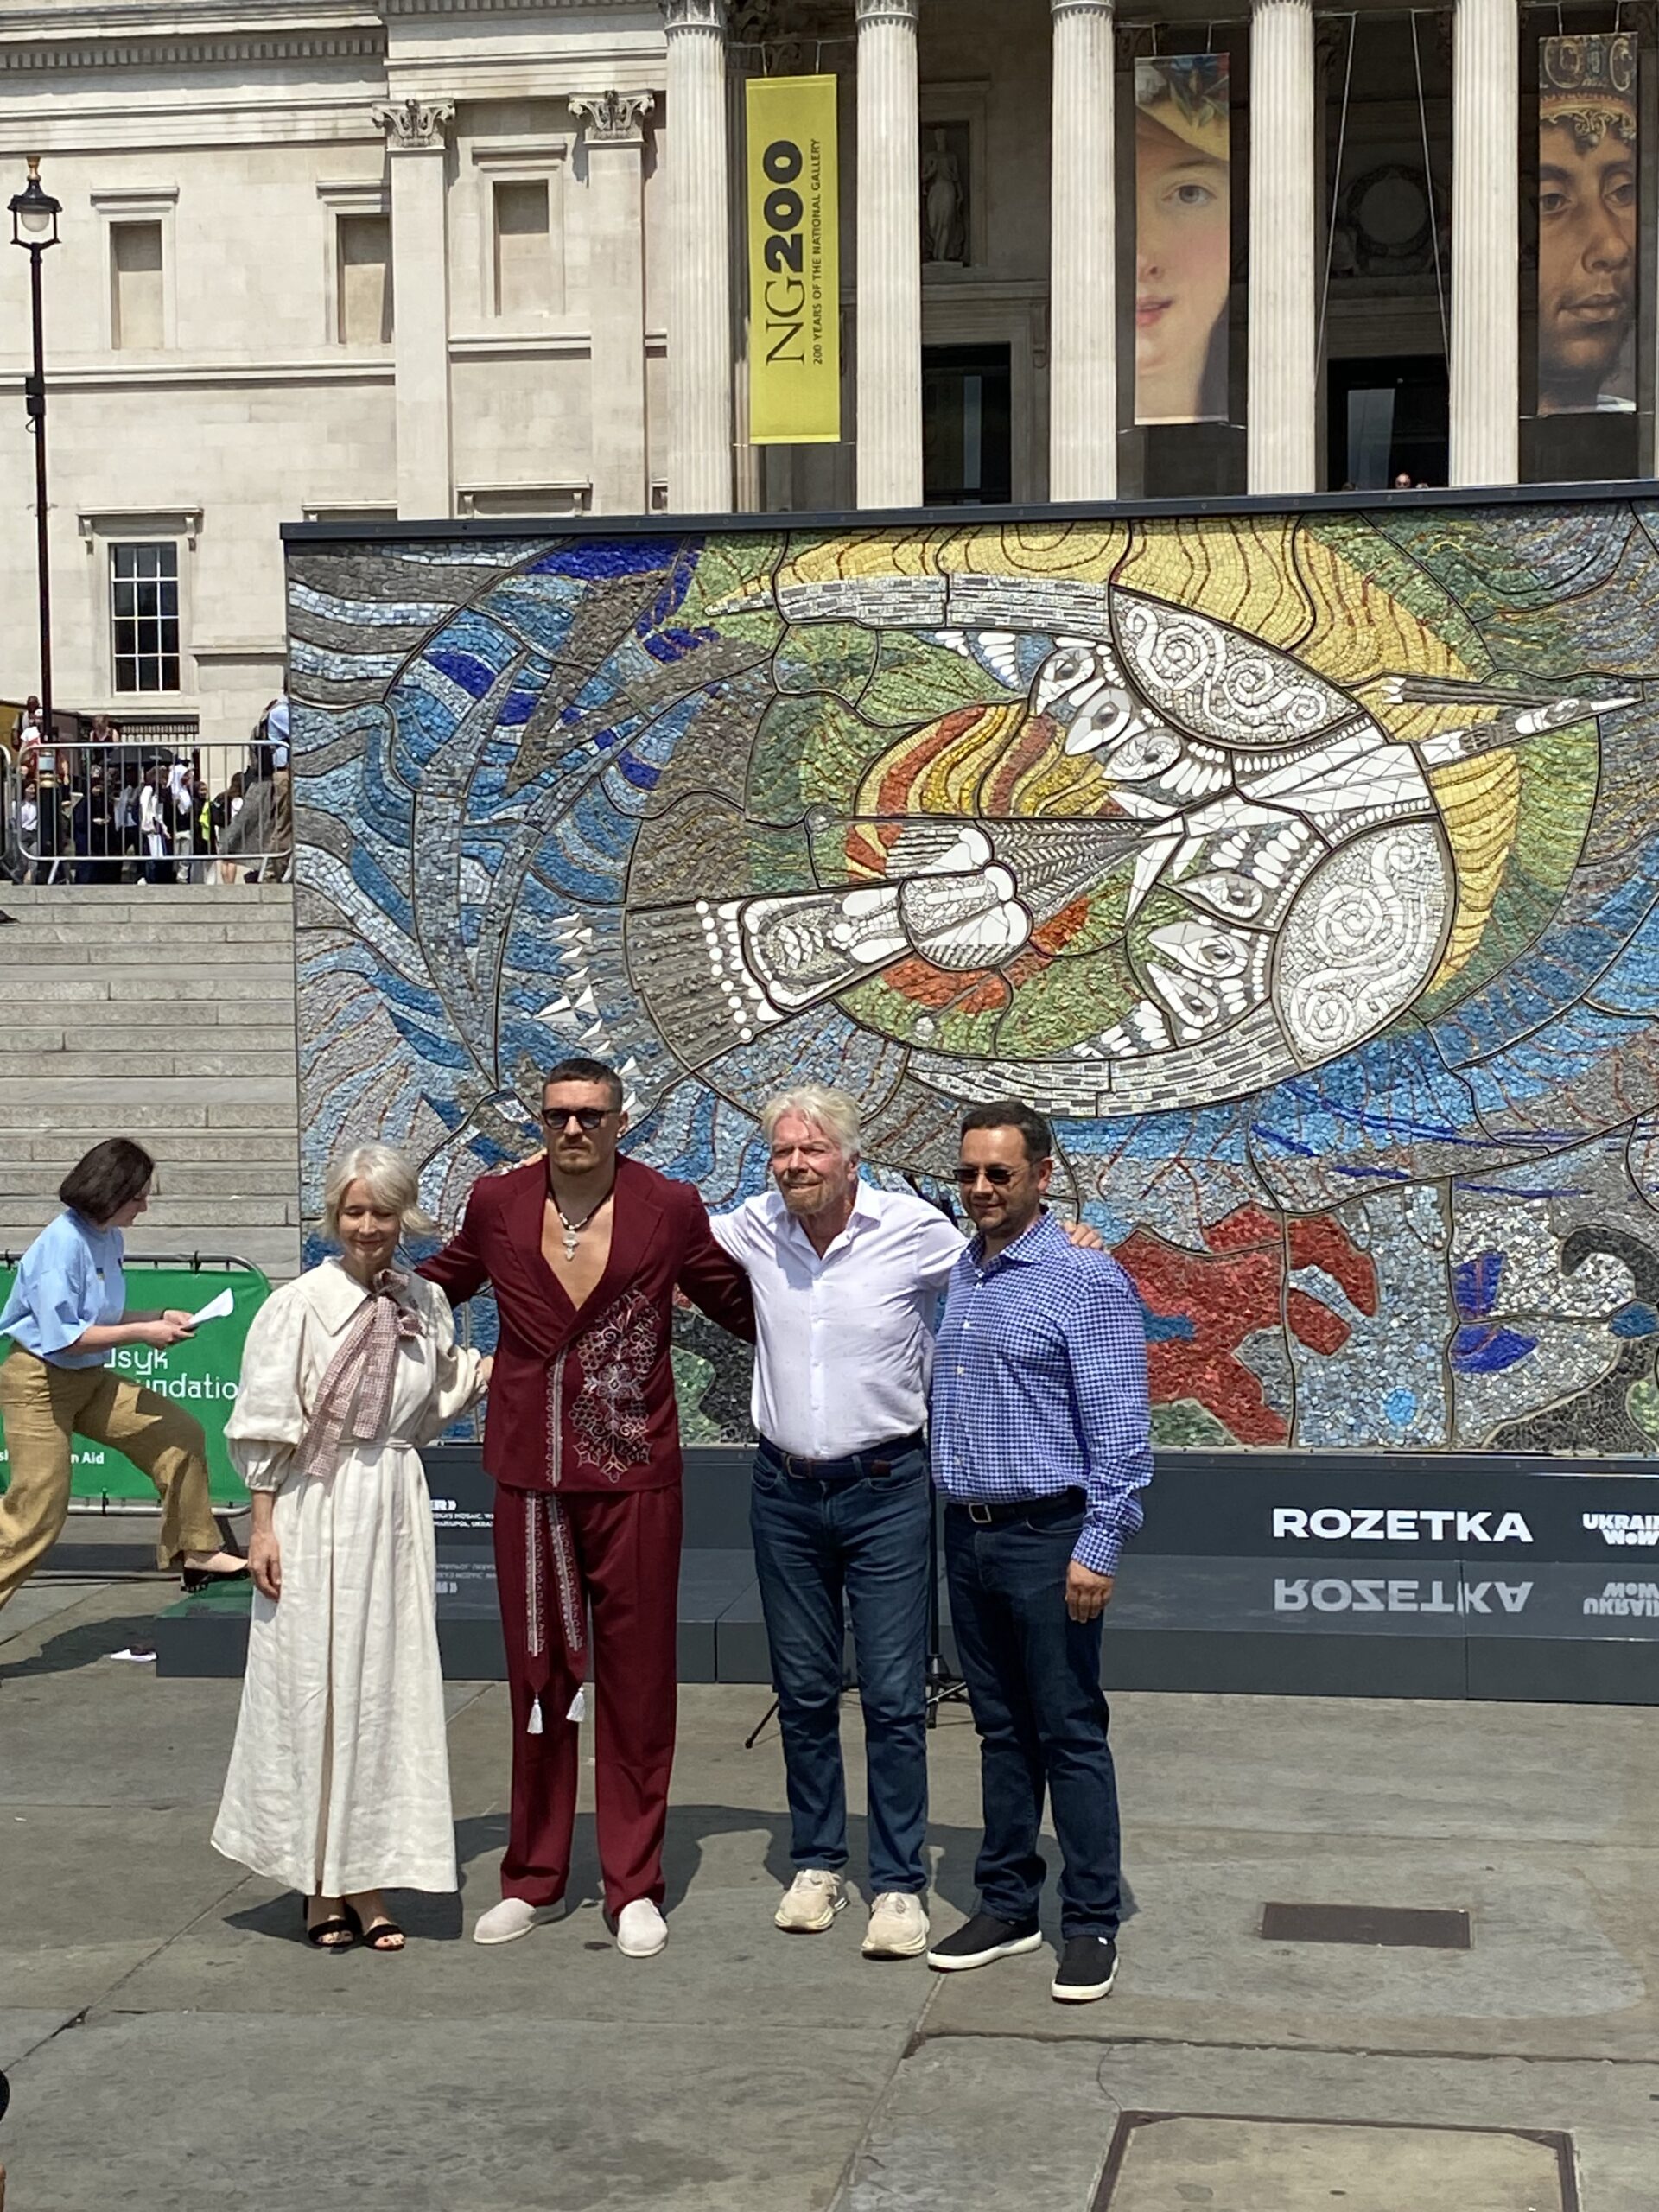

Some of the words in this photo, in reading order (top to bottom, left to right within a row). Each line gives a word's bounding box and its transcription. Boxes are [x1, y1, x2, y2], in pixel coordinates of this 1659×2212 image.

[810, 139, 821, 191] GALLERY
[811, 195, 821, 254] NATIONAL
[763, 140, 805, 366] NG200
[812, 259, 821, 281] THE
[812, 285, 822, 299] OF
[812, 304, 823, 341] YEARS
[812, 346, 823, 365] 200
[82, 1452, 105, 1464] Aid
[1272, 1508, 1534, 1543] ROZETKA
